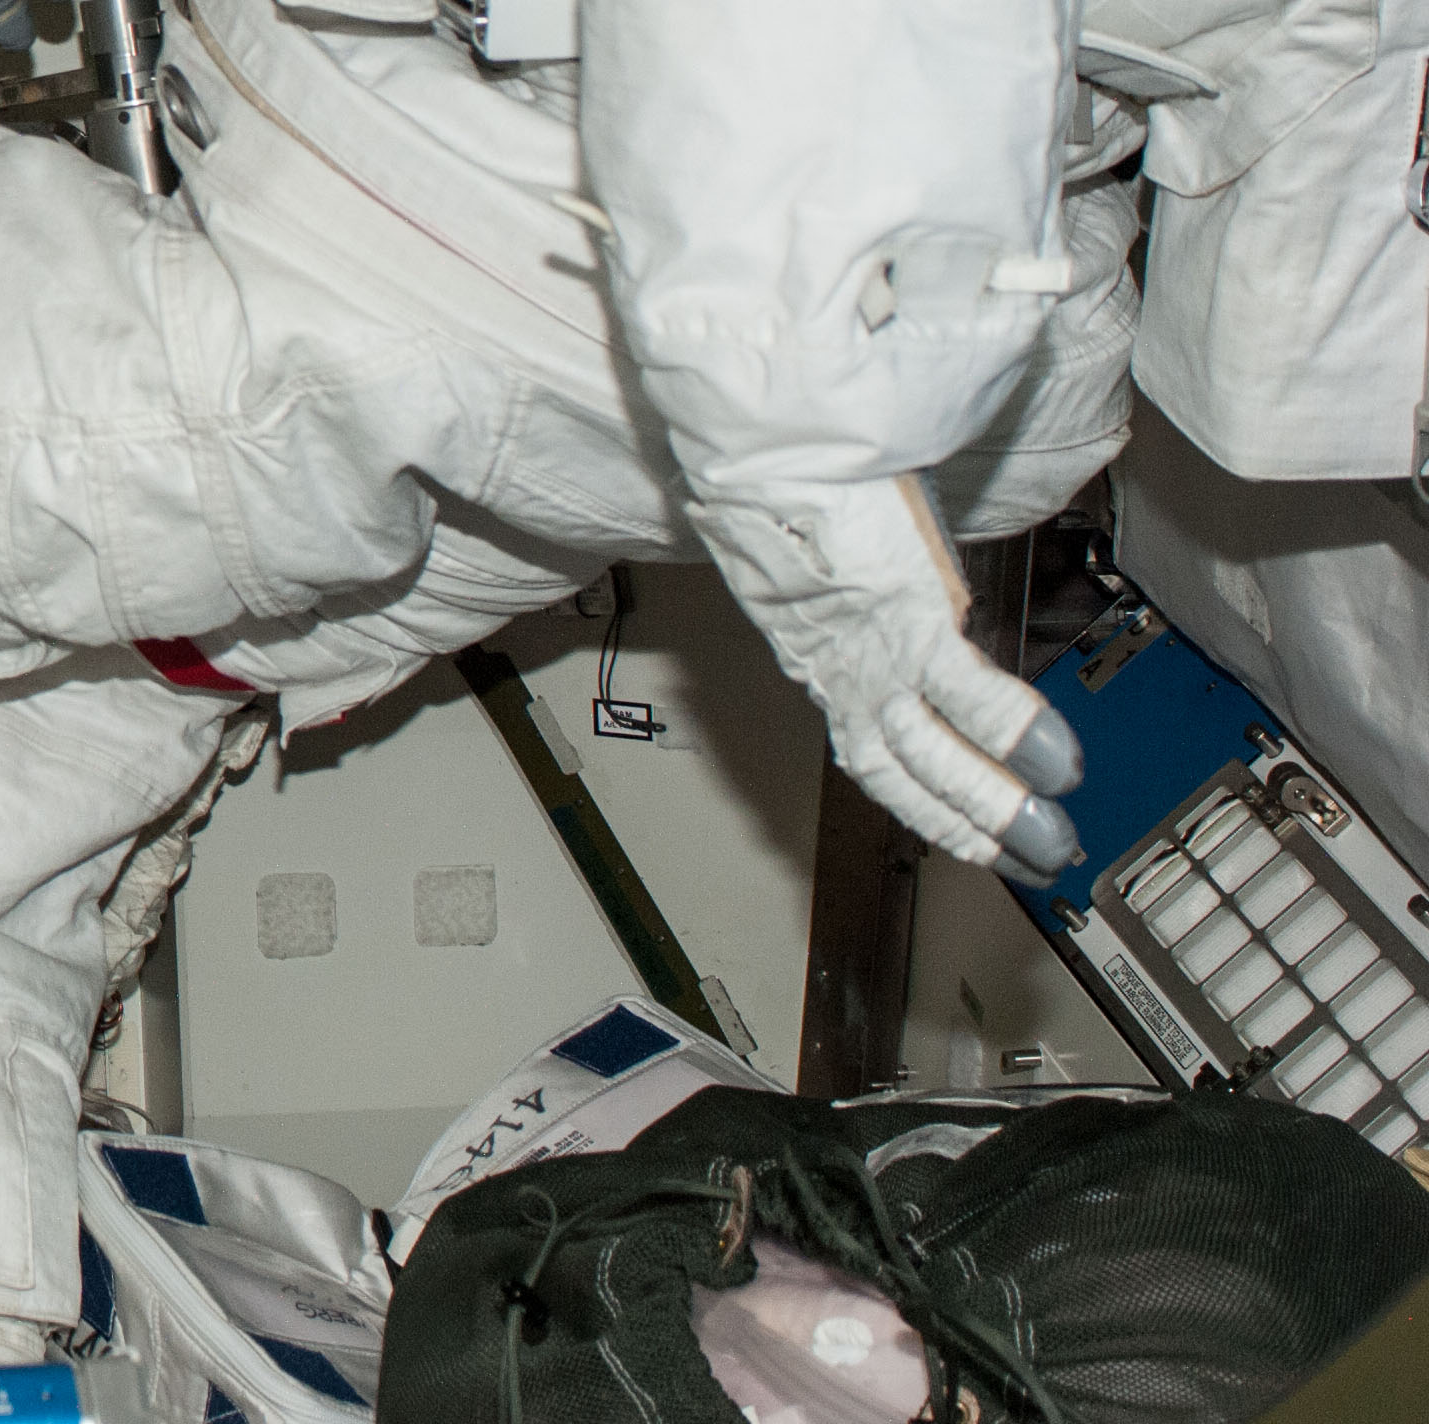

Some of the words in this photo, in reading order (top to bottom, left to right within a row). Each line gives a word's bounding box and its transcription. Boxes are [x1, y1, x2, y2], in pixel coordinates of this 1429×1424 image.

[1118, 964, 1141, 989] TORQUE
[1137, 987, 1158, 1010] UPPER
[1153, 1007, 1173, 1029] BOLTS
[1169, 1027, 1181, 1038] TO
[1125, 987, 1146, 1009] ABOVE
[1142, 1007, 1168, 1037] RUNNING
[1163, 1034, 1187, 1061] TORQUE
